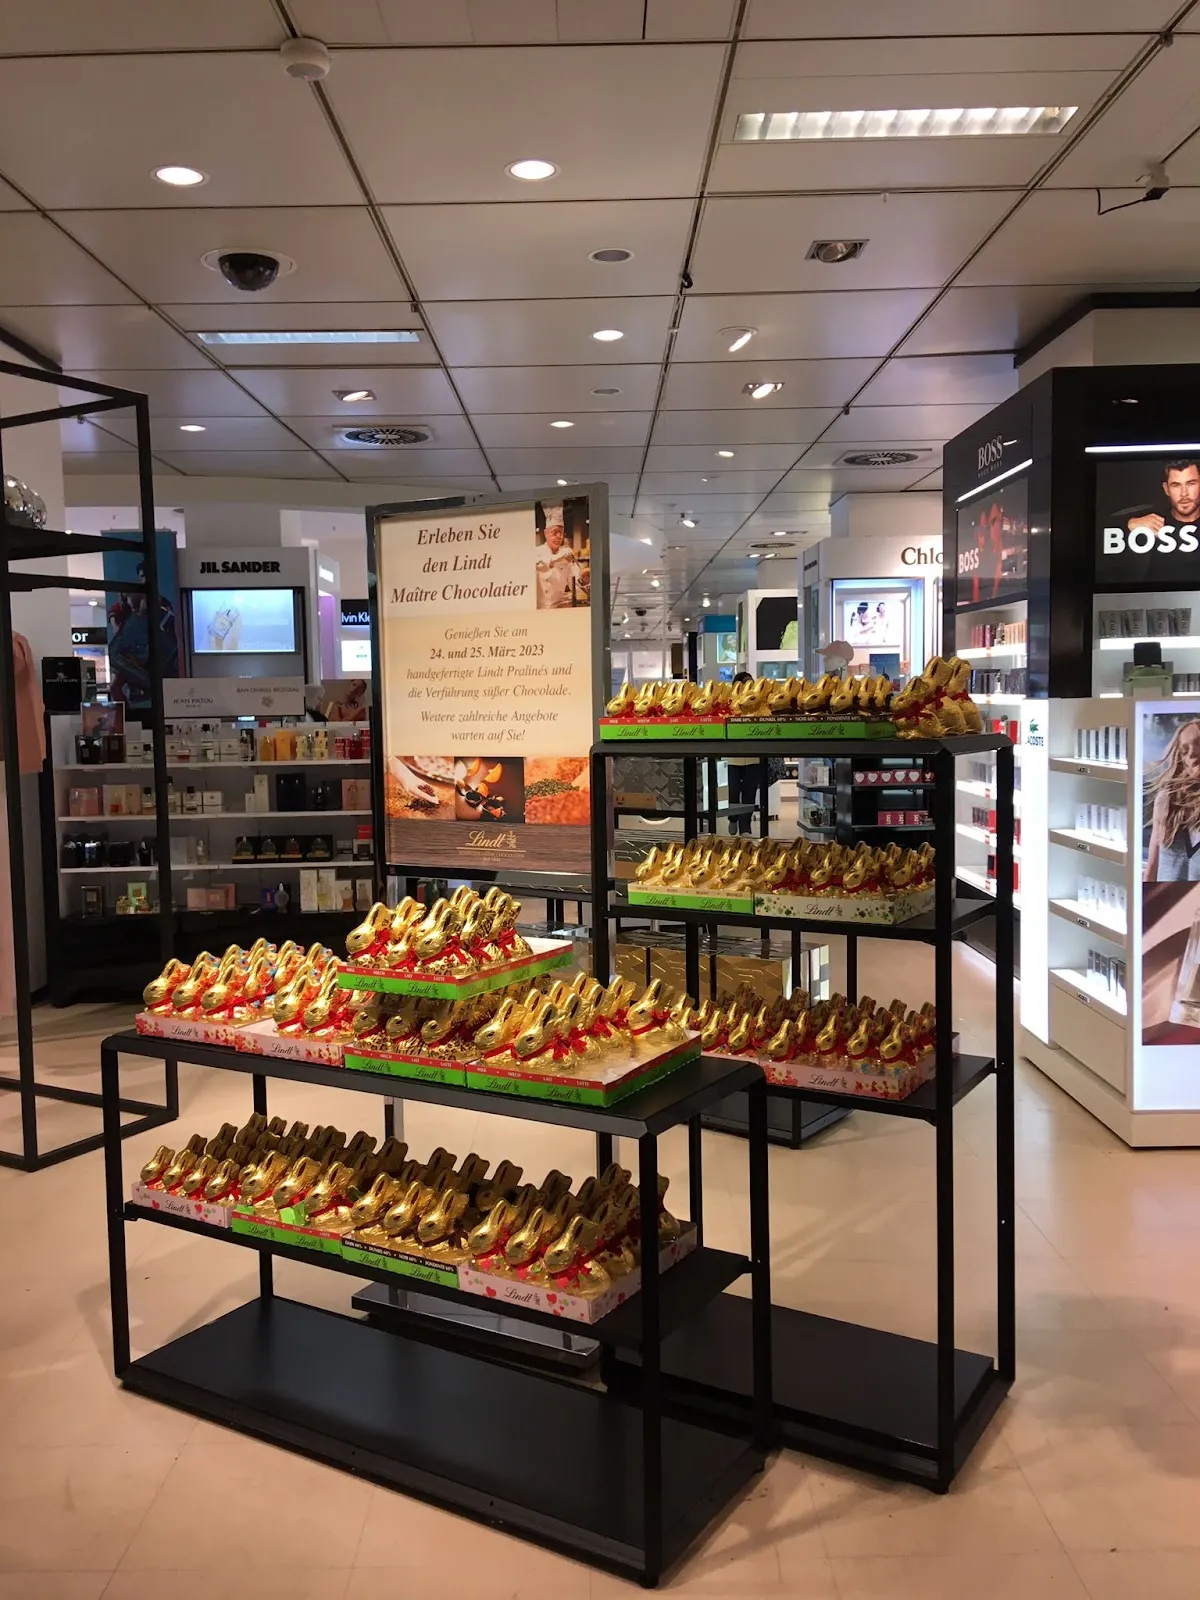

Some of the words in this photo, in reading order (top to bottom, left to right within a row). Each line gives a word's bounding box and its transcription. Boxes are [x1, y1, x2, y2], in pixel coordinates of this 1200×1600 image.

[978, 435, 1002, 470] BOSS
[417, 527, 473, 545] Erleben
[478, 524, 501, 541] Sie
[1103, 525, 1199, 554] BOSS
[422, 558, 448, 573] den
[453, 553, 492, 572] Lindt
[958, 547, 980, 574] BOSS
[200, 562, 220, 574] JIL
[222, 561, 280, 574] SANDER
[391, 587, 438, 604] Maître
[442, 581, 528, 601] Chocolatier
[72, 632, 88, 642] or
[444, 627, 490, 641] Genießen
[494, 626, 510, 638] Sie
[512, 628, 528, 637] am
[430, 648, 445, 660] 24.
[448, 647, 467, 659] und
[470, 647, 485, 658] 25.
[488, 646, 516, 658] März
[519, 644, 544, 656] 2023
[406, 668, 474, 682] handgefertigte
[478, 666, 504, 678] Lindt
[507, 664, 548, 677] Pralinés
[551, 663, 573, 676] und
[408, 687, 422, 699] die
[426, 686, 479, 700] Verführung
[482, 686, 510, 700] süßer
[513, 684, 572, 697] Chocolade.
[420, 710, 456, 722] Weitere
[458, 710, 508, 723] zahlreiche
[511, 709, 559, 724] Angebote
[451, 731, 484, 740] warten
[487, 729, 504, 742] auf
[506, 729, 526, 741] Sie!
[617, 726, 640, 736] Lindt
[672, 726, 696, 736] Lindt
[746, 725, 774, 736] Lindt
[808, 725, 836, 736] Lindt
[1025, 736, 1044, 746] ACOSTE
[465, 830, 506, 848] Lindt
[646, 896, 668, 906] Lindt
[701, 898, 724, 910] Lindt
[804, 904, 835, 916] Lindt
[354, 977, 378, 989] Lindt
[407, 982, 431, 994] Lindt
[171, 1026, 192, 1037] Lindt
[271, 1042, 294, 1054] Lindt
[362, 1060, 384, 1071] Lindt
[415, 1067, 438, 1078] Lindt
[486, 1078, 512, 1091] Lindt
[808, 1074, 842, 1086] Lindt
[547, 1086, 574, 1099] Lindt
[165, 1200, 185, 1212] Lindt
[248, 1224, 268, 1237] Lindt
[296, 1235, 317, 1247] Lindt
[360, 1253, 381, 1266] Lindt
[411, 1265, 433, 1279] Lindt
[504, 1287, 532, 1302] Lindt
